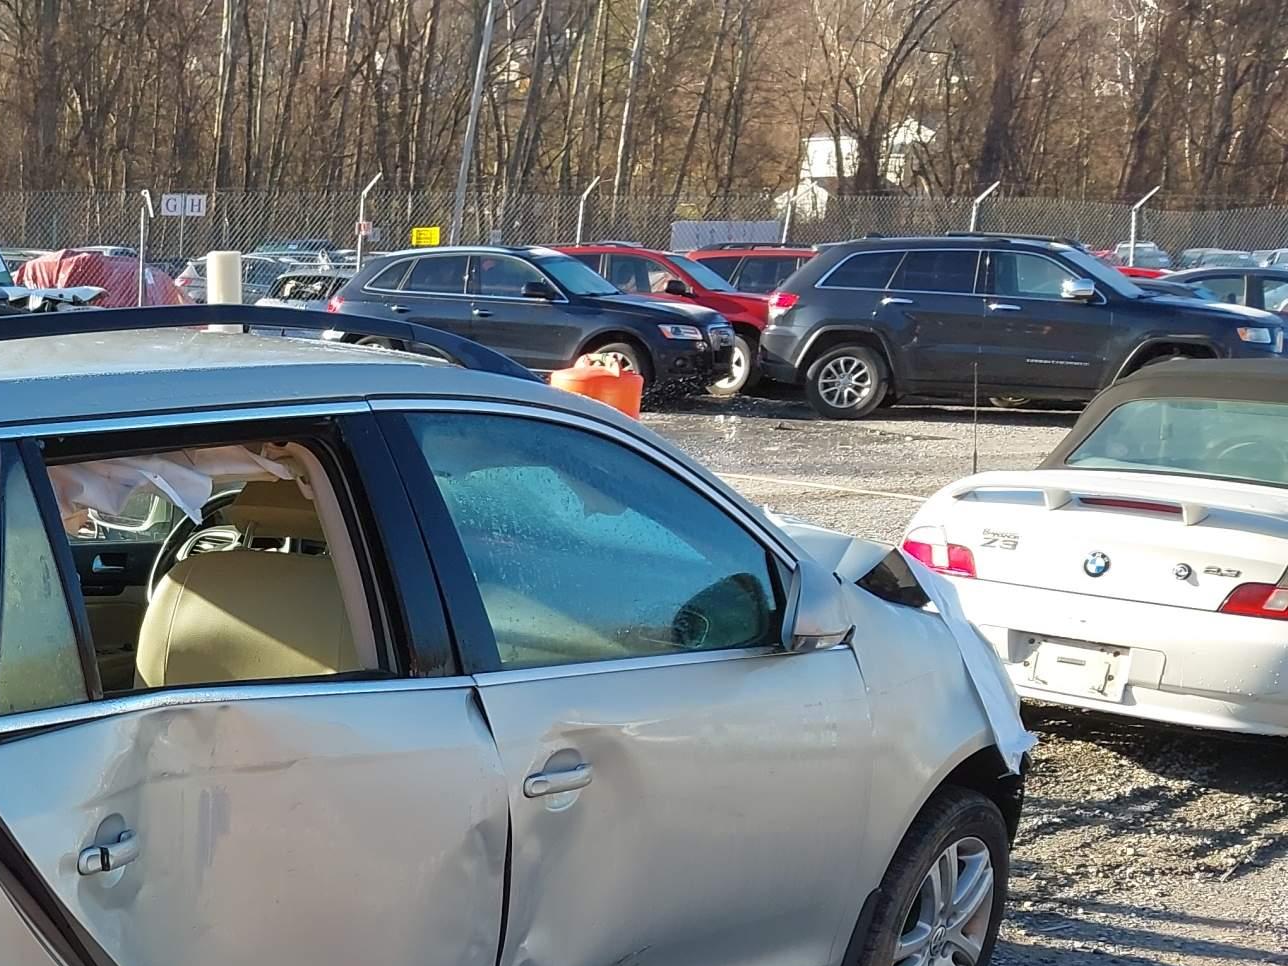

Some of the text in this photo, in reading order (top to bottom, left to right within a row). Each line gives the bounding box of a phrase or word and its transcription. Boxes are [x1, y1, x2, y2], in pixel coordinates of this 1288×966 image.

[165, 198, 178, 213] G
[190, 198, 202, 213] H
[980, 537, 1019, 551] Z3
